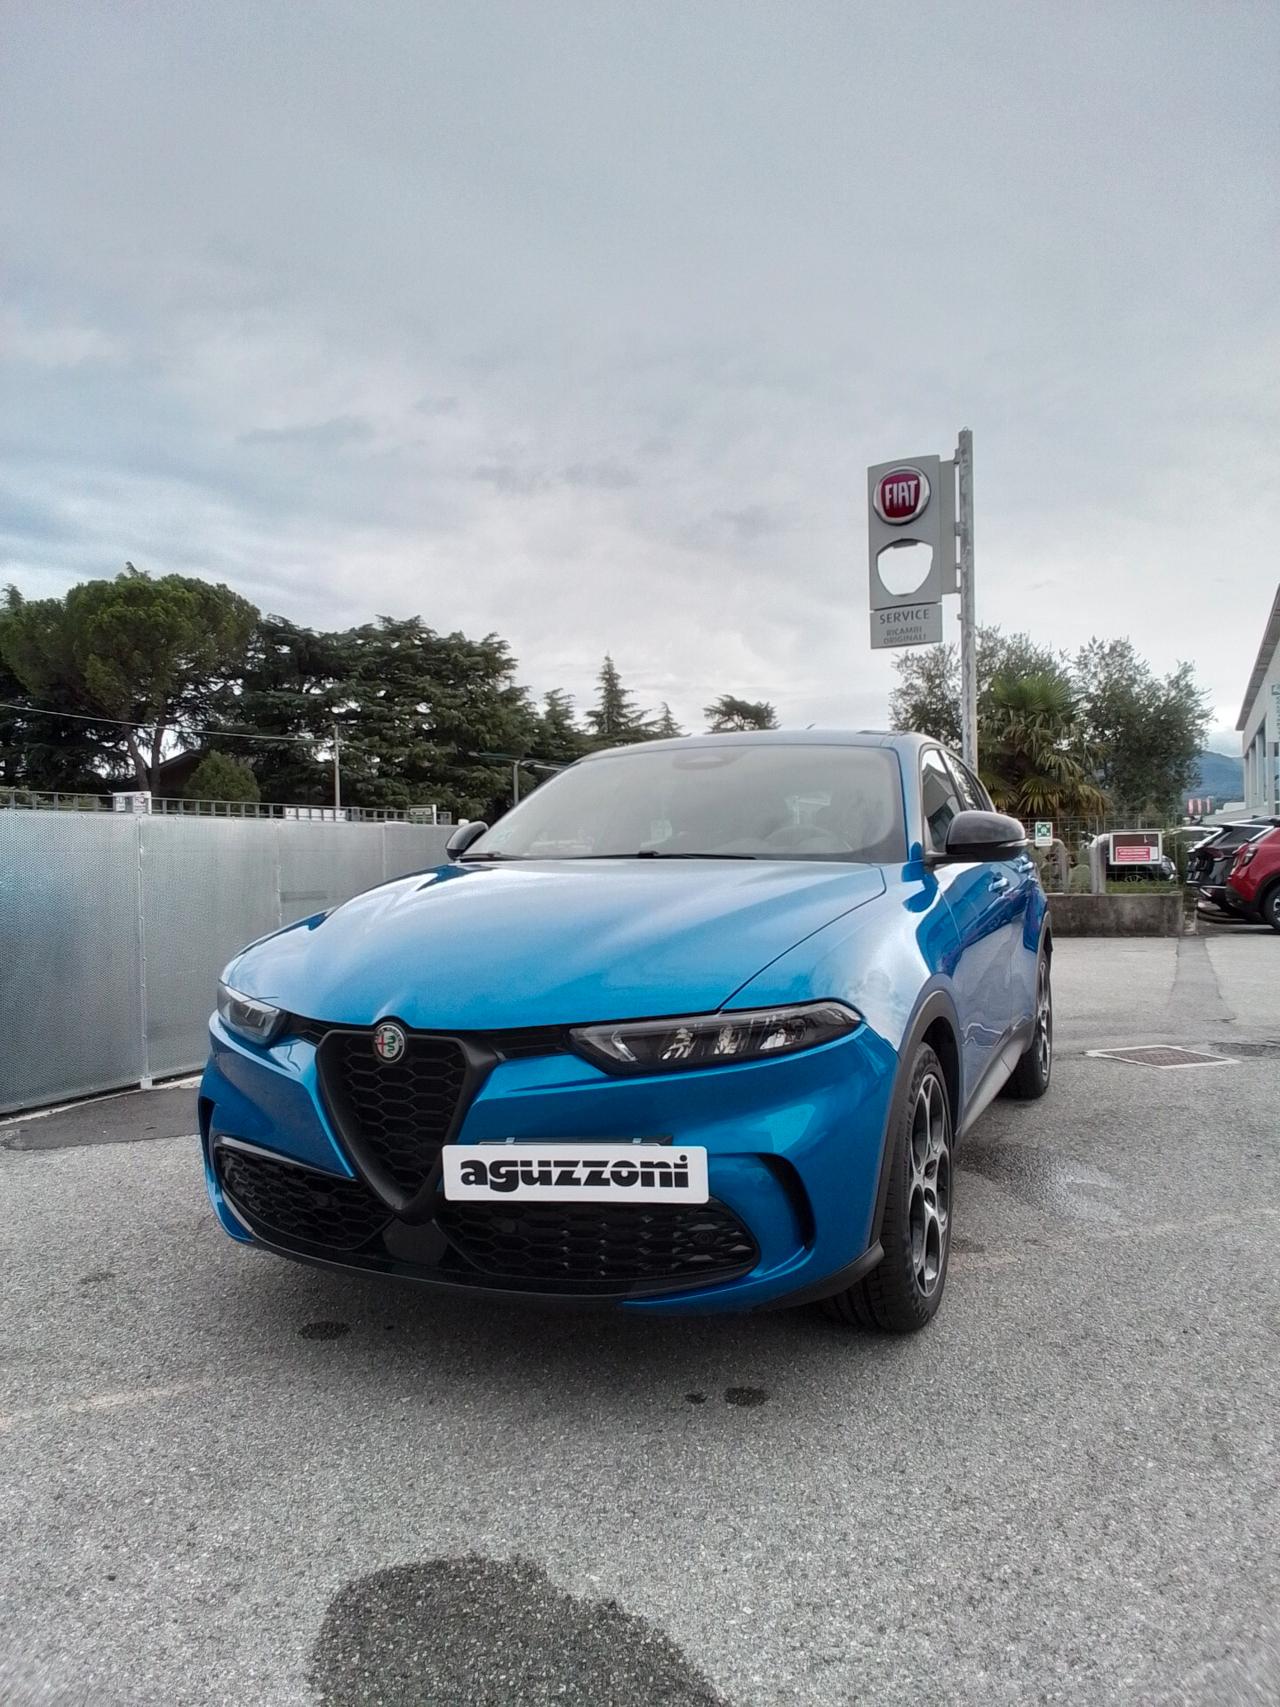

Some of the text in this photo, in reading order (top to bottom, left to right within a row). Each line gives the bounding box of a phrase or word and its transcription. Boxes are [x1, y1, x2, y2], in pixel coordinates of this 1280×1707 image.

[884, 480, 919, 510] FIAT
[880, 608, 929, 624] SERVICE
[460, 1154, 689, 1192] aguzzoni
